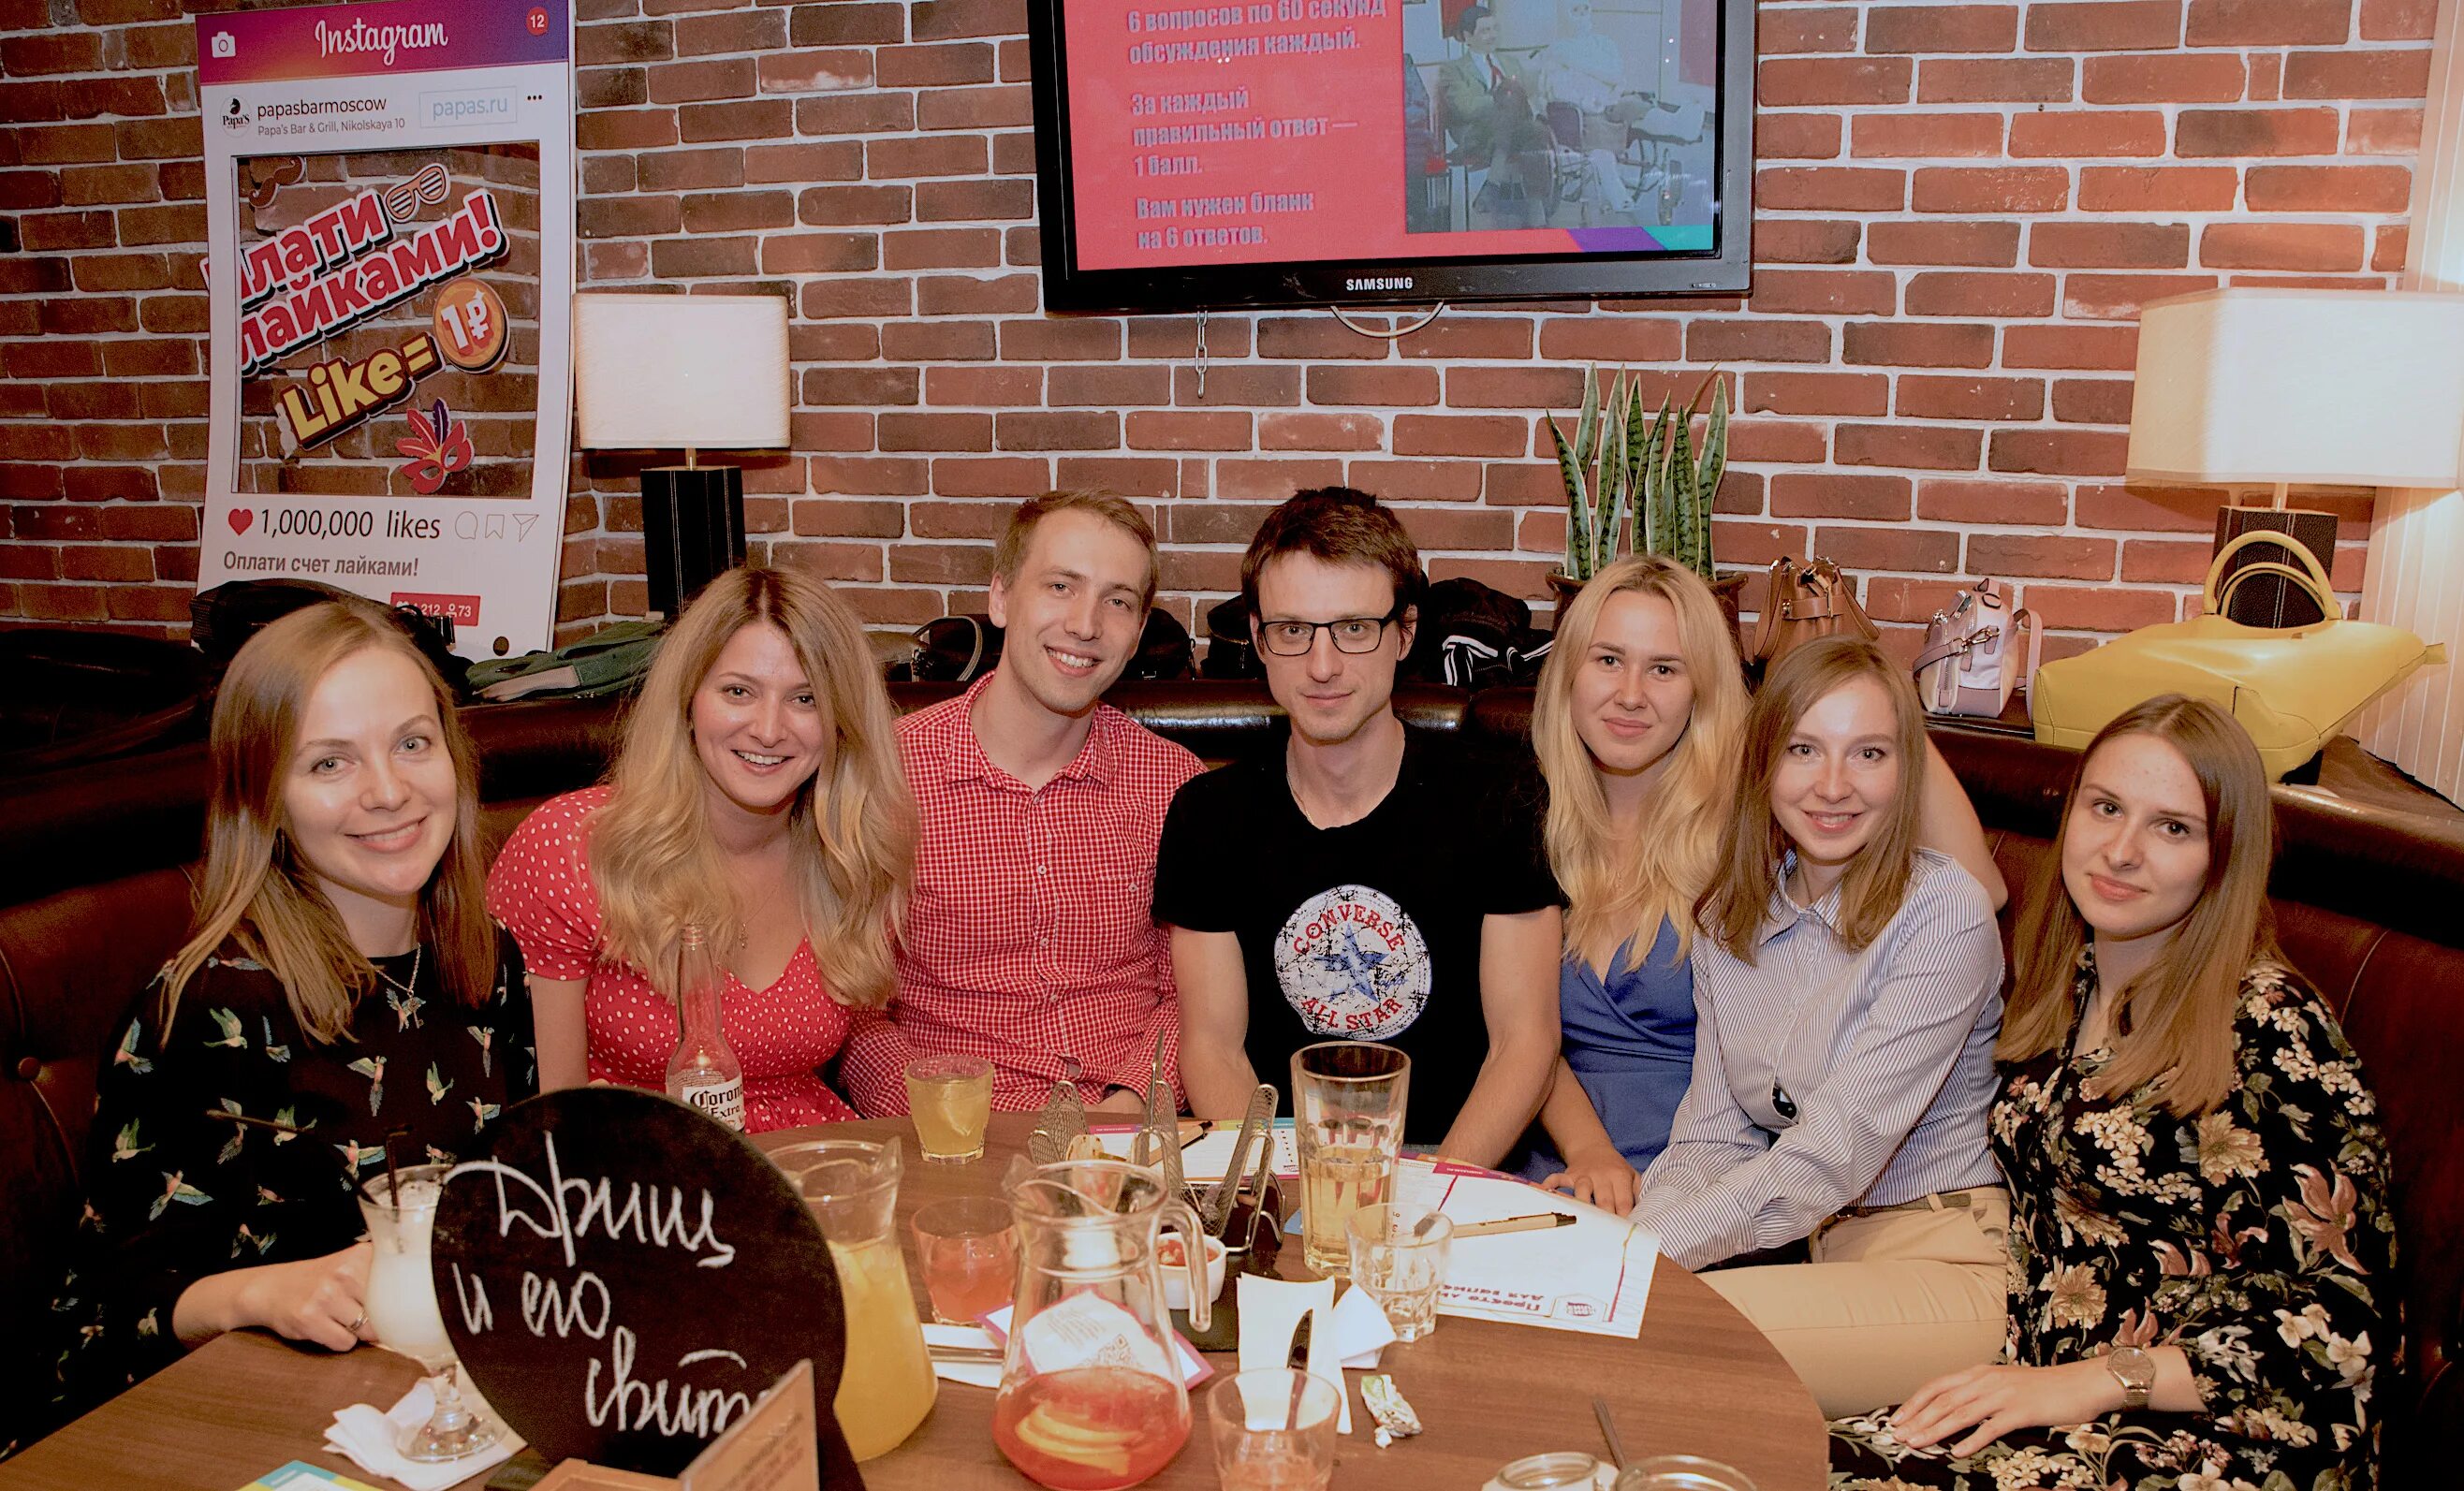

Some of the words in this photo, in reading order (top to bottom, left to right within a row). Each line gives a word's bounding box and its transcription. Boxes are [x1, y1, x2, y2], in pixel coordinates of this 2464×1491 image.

[529, 14, 545, 29] 12
[1128, 10, 1140, 33] 6
[1145, 6, 1243, 32] вопросов
[1247, 5, 1273, 24] по
[1277, 0, 1303, 21] 60
[1309, 0, 1386, 19] секунд
[315, 17, 448, 66] Instagram
[1129, 37, 1260, 65] обсуждения
[1265, 25, 1361, 55] каждый.
[257, 97, 387, 120] papasbarmoscow
[432, 87, 508, 122] papas.ru
[1131, 94, 1156, 116] За
[1160, 86, 1249, 113] каждый
[257, 124, 288, 138] Papa's
[290, 124, 306, 134] Bar
[309, 123, 315, 133] &
[317, 121, 339, 134] Grill,
[341, 118, 392, 132] Nikolskaya
[394, 117, 405, 128] 10
[1133, 117, 1265, 148] правильный
[1269, 116, 1328, 138] ответ
[1134, 156, 1144, 177] 1
[1148, 154, 1203, 176] балл.
[1137, 197, 1177, 219] Вам
[1181, 196, 1246, 218] нужен
[1251, 192, 1314, 214] бланк
[1137, 230, 1162, 250] на
[1166, 226, 1179, 249] 6
[1182, 226, 1269, 247] ответов.
[1346, 277, 1414, 291] SAMSUNG
[260, 508, 374, 541] 1,000,000
[387, 509, 441, 540] likes
[223, 550, 286, 572] Оплати
[290, 557, 330, 575] счет
[334, 554, 418, 577] лайками!
[458, 605, 472, 618] 73
[1293, 903, 1406, 955] CONVERSE
[1301, 996, 1339, 1029] ALL
[1345, 997, 1404, 1031] STAR
[584, 1324, 770, 1439] свит
